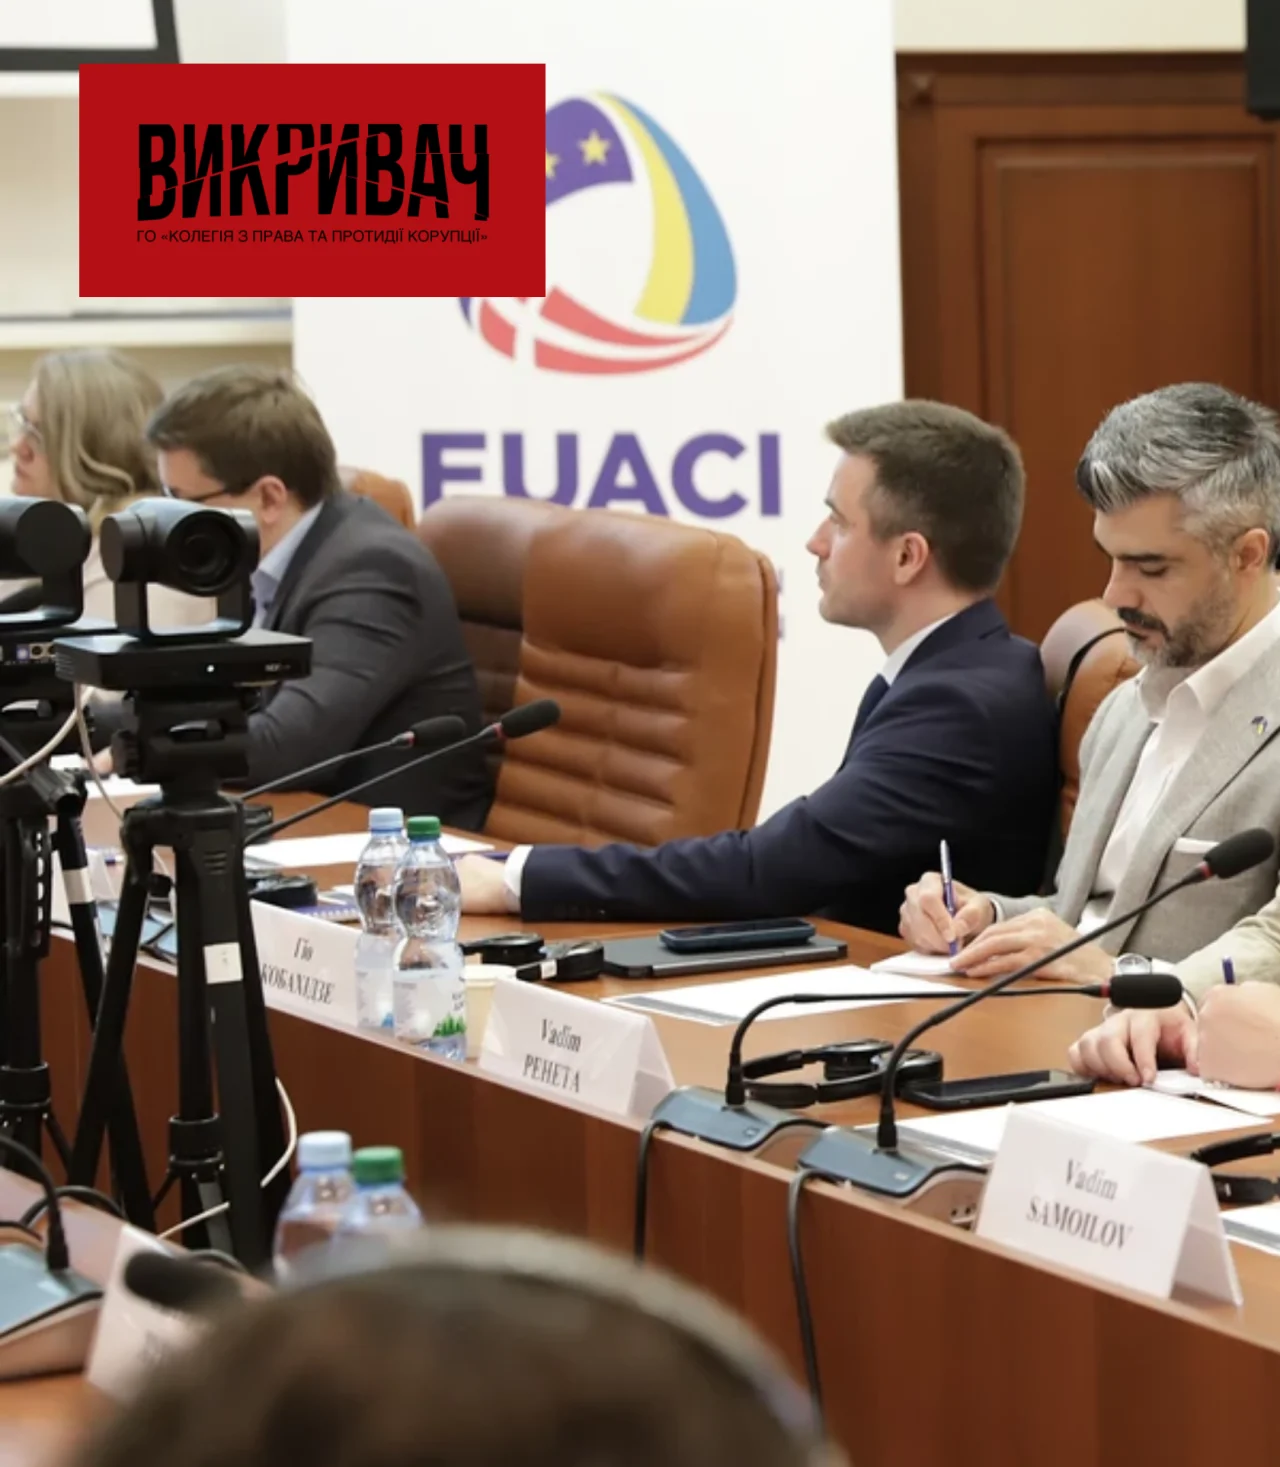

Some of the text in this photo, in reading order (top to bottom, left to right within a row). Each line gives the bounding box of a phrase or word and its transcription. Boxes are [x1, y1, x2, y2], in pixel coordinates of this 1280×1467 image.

[421, 432, 781, 519] EUACI
[541, 1018, 581, 1052] Vadim
[1066, 1158, 1118, 1200] Vadim
[1026, 1196, 1134, 1249] SAMOILOV
